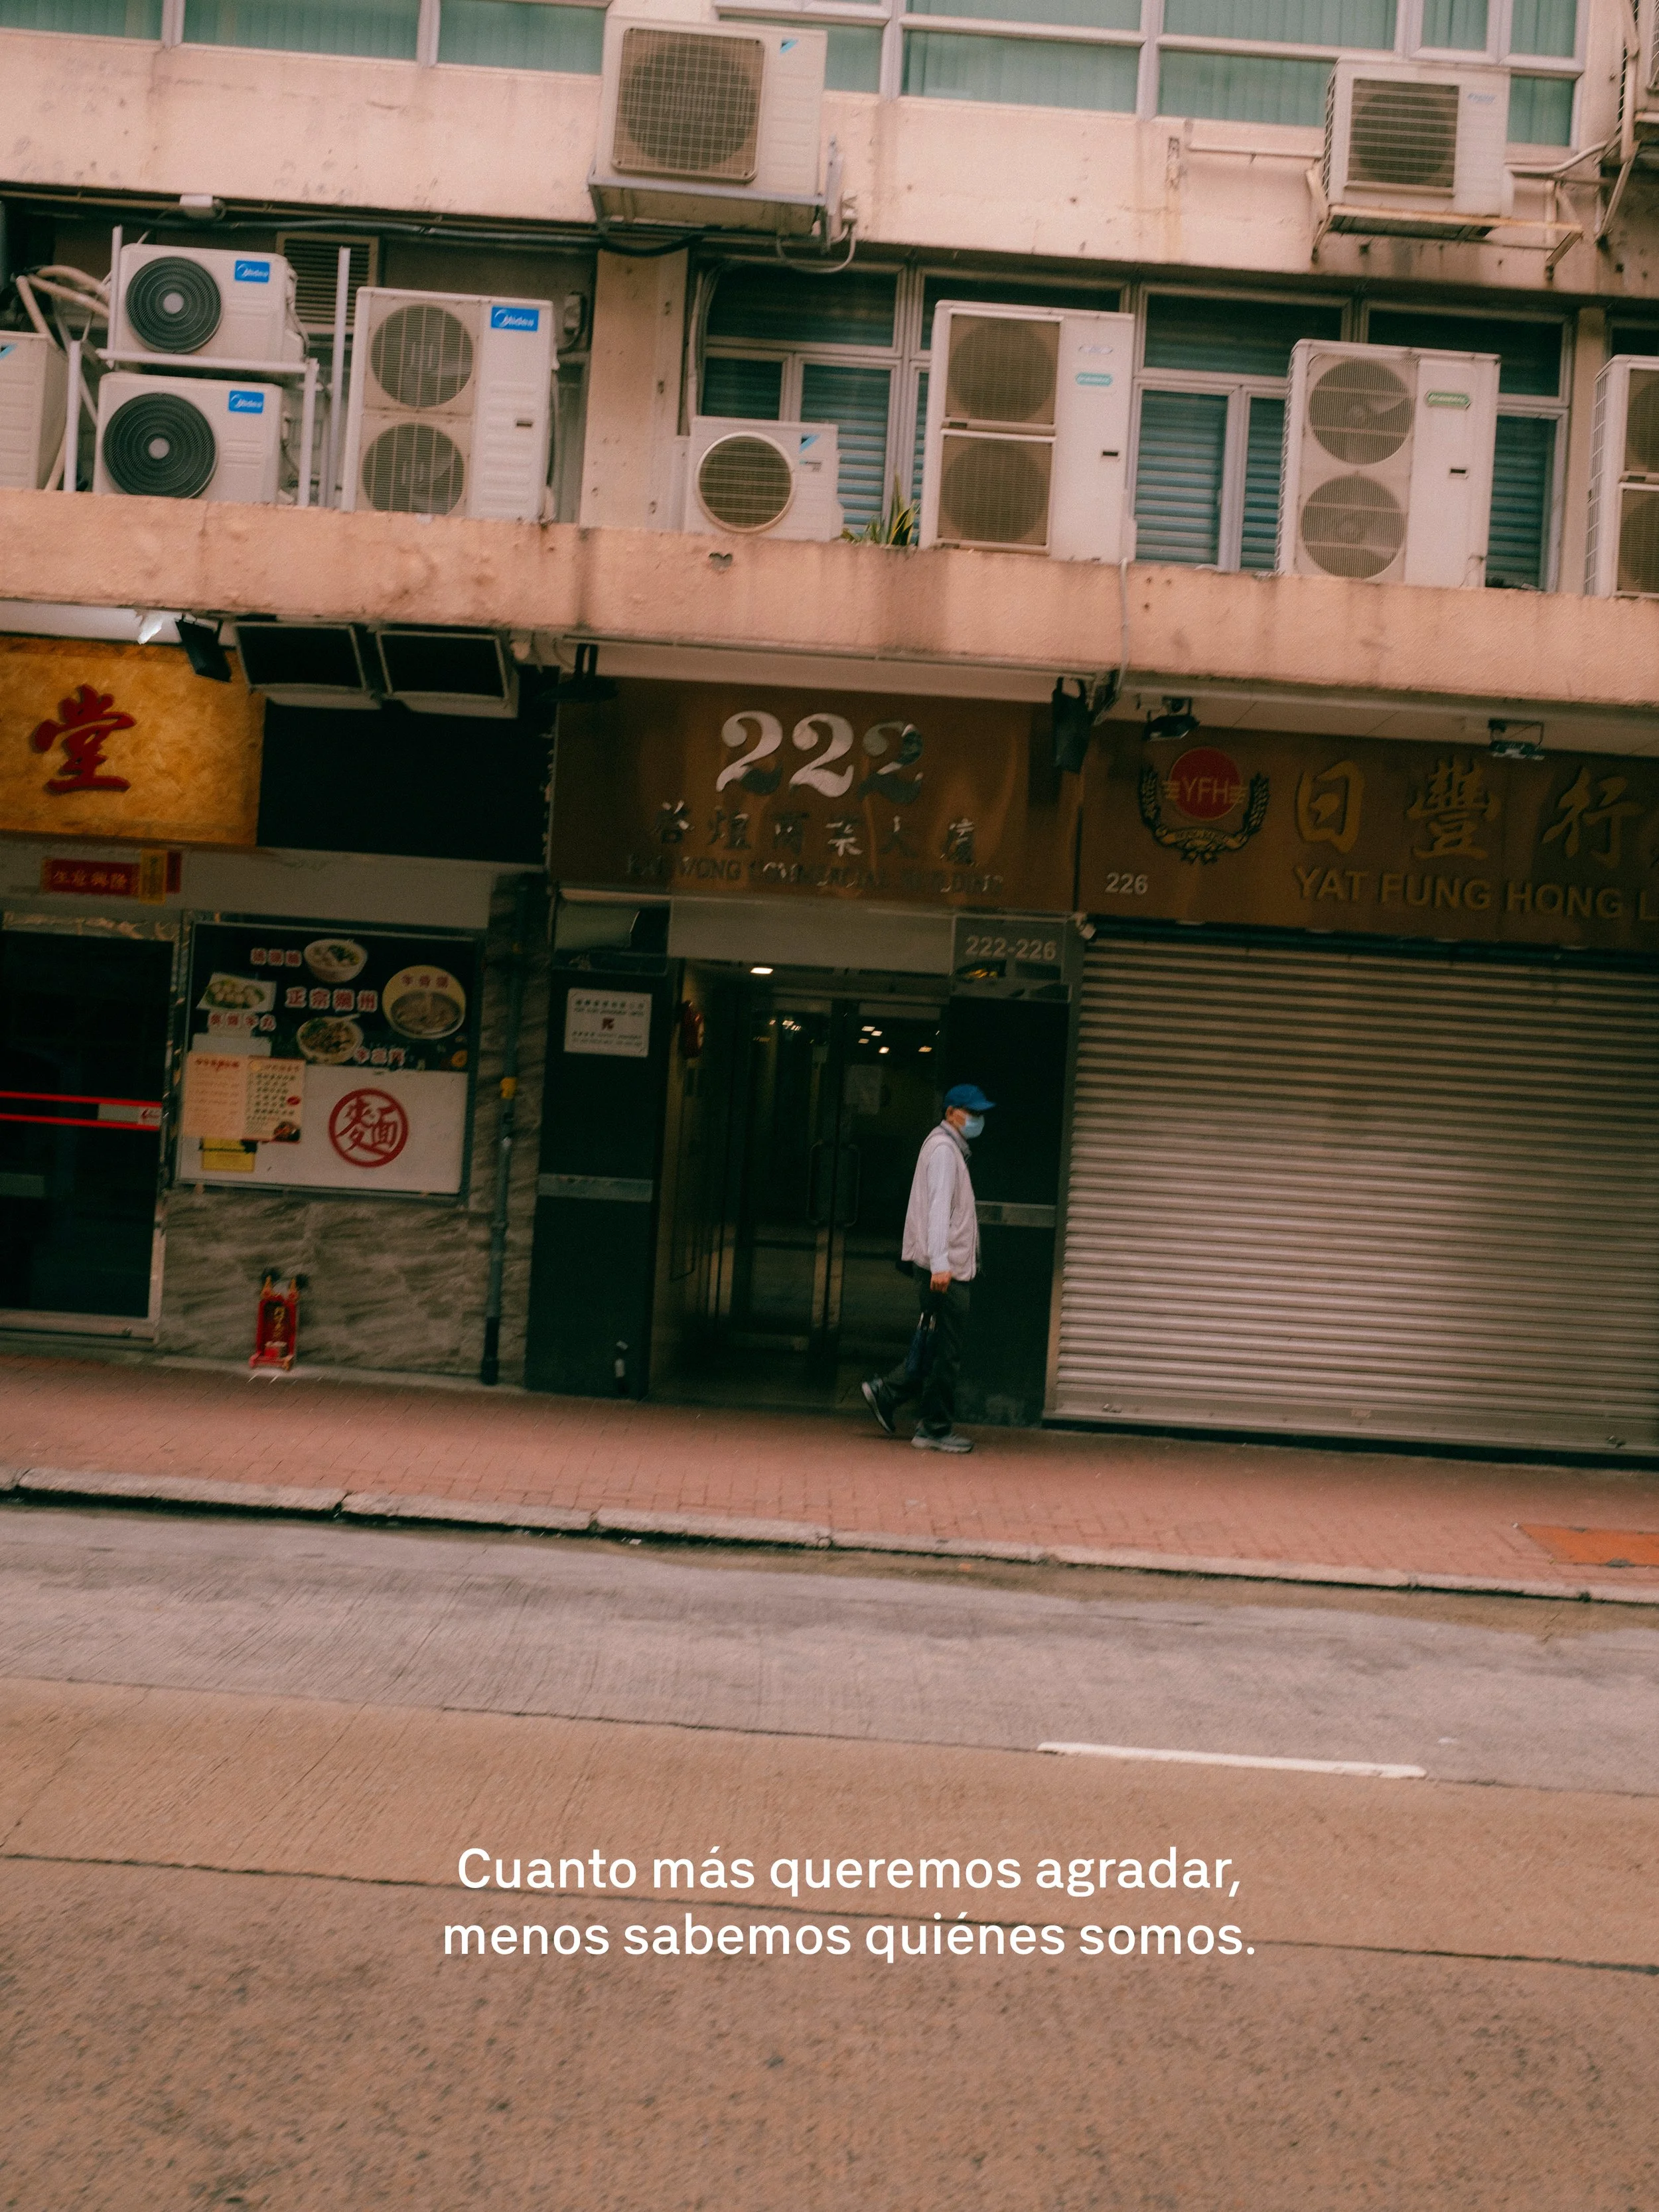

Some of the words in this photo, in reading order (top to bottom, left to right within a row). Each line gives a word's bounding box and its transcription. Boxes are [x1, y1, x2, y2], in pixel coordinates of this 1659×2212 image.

[498, 314, 535, 328] Midea
[31, 682, 137, 796] 堂
[716, 709, 925, 805] 222
[1179, 775, 1232, 806] YFH
[680, 855, 742, 881] WONG
[1104, 871, 1149, 896] 226
[1293, 865, 1369, 903] YAT
[1380, 873, 1492, 911] FUNG
[1506, 880, 1624, 920] HONG
[965, 934, 1057, 962] 222-226
